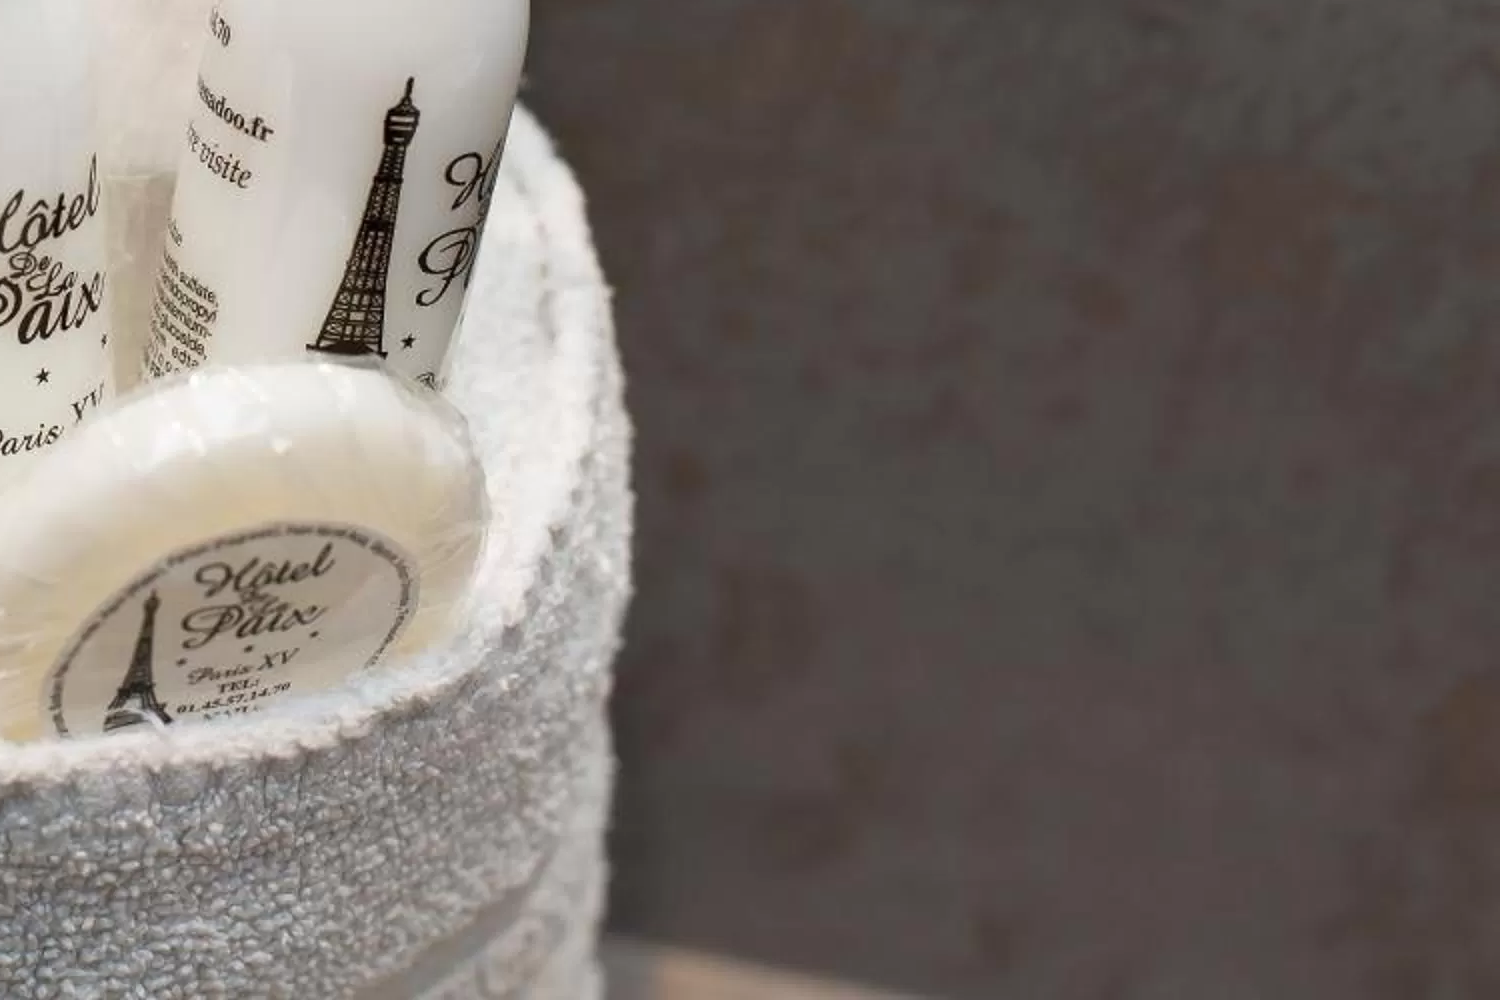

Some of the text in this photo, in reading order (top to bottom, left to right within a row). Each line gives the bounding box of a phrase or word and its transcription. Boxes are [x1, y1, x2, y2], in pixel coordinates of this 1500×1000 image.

[200, 142, 252, 189] visite
[9, 247, 52, 278] De
[180, 604, 329, 650] Paix
